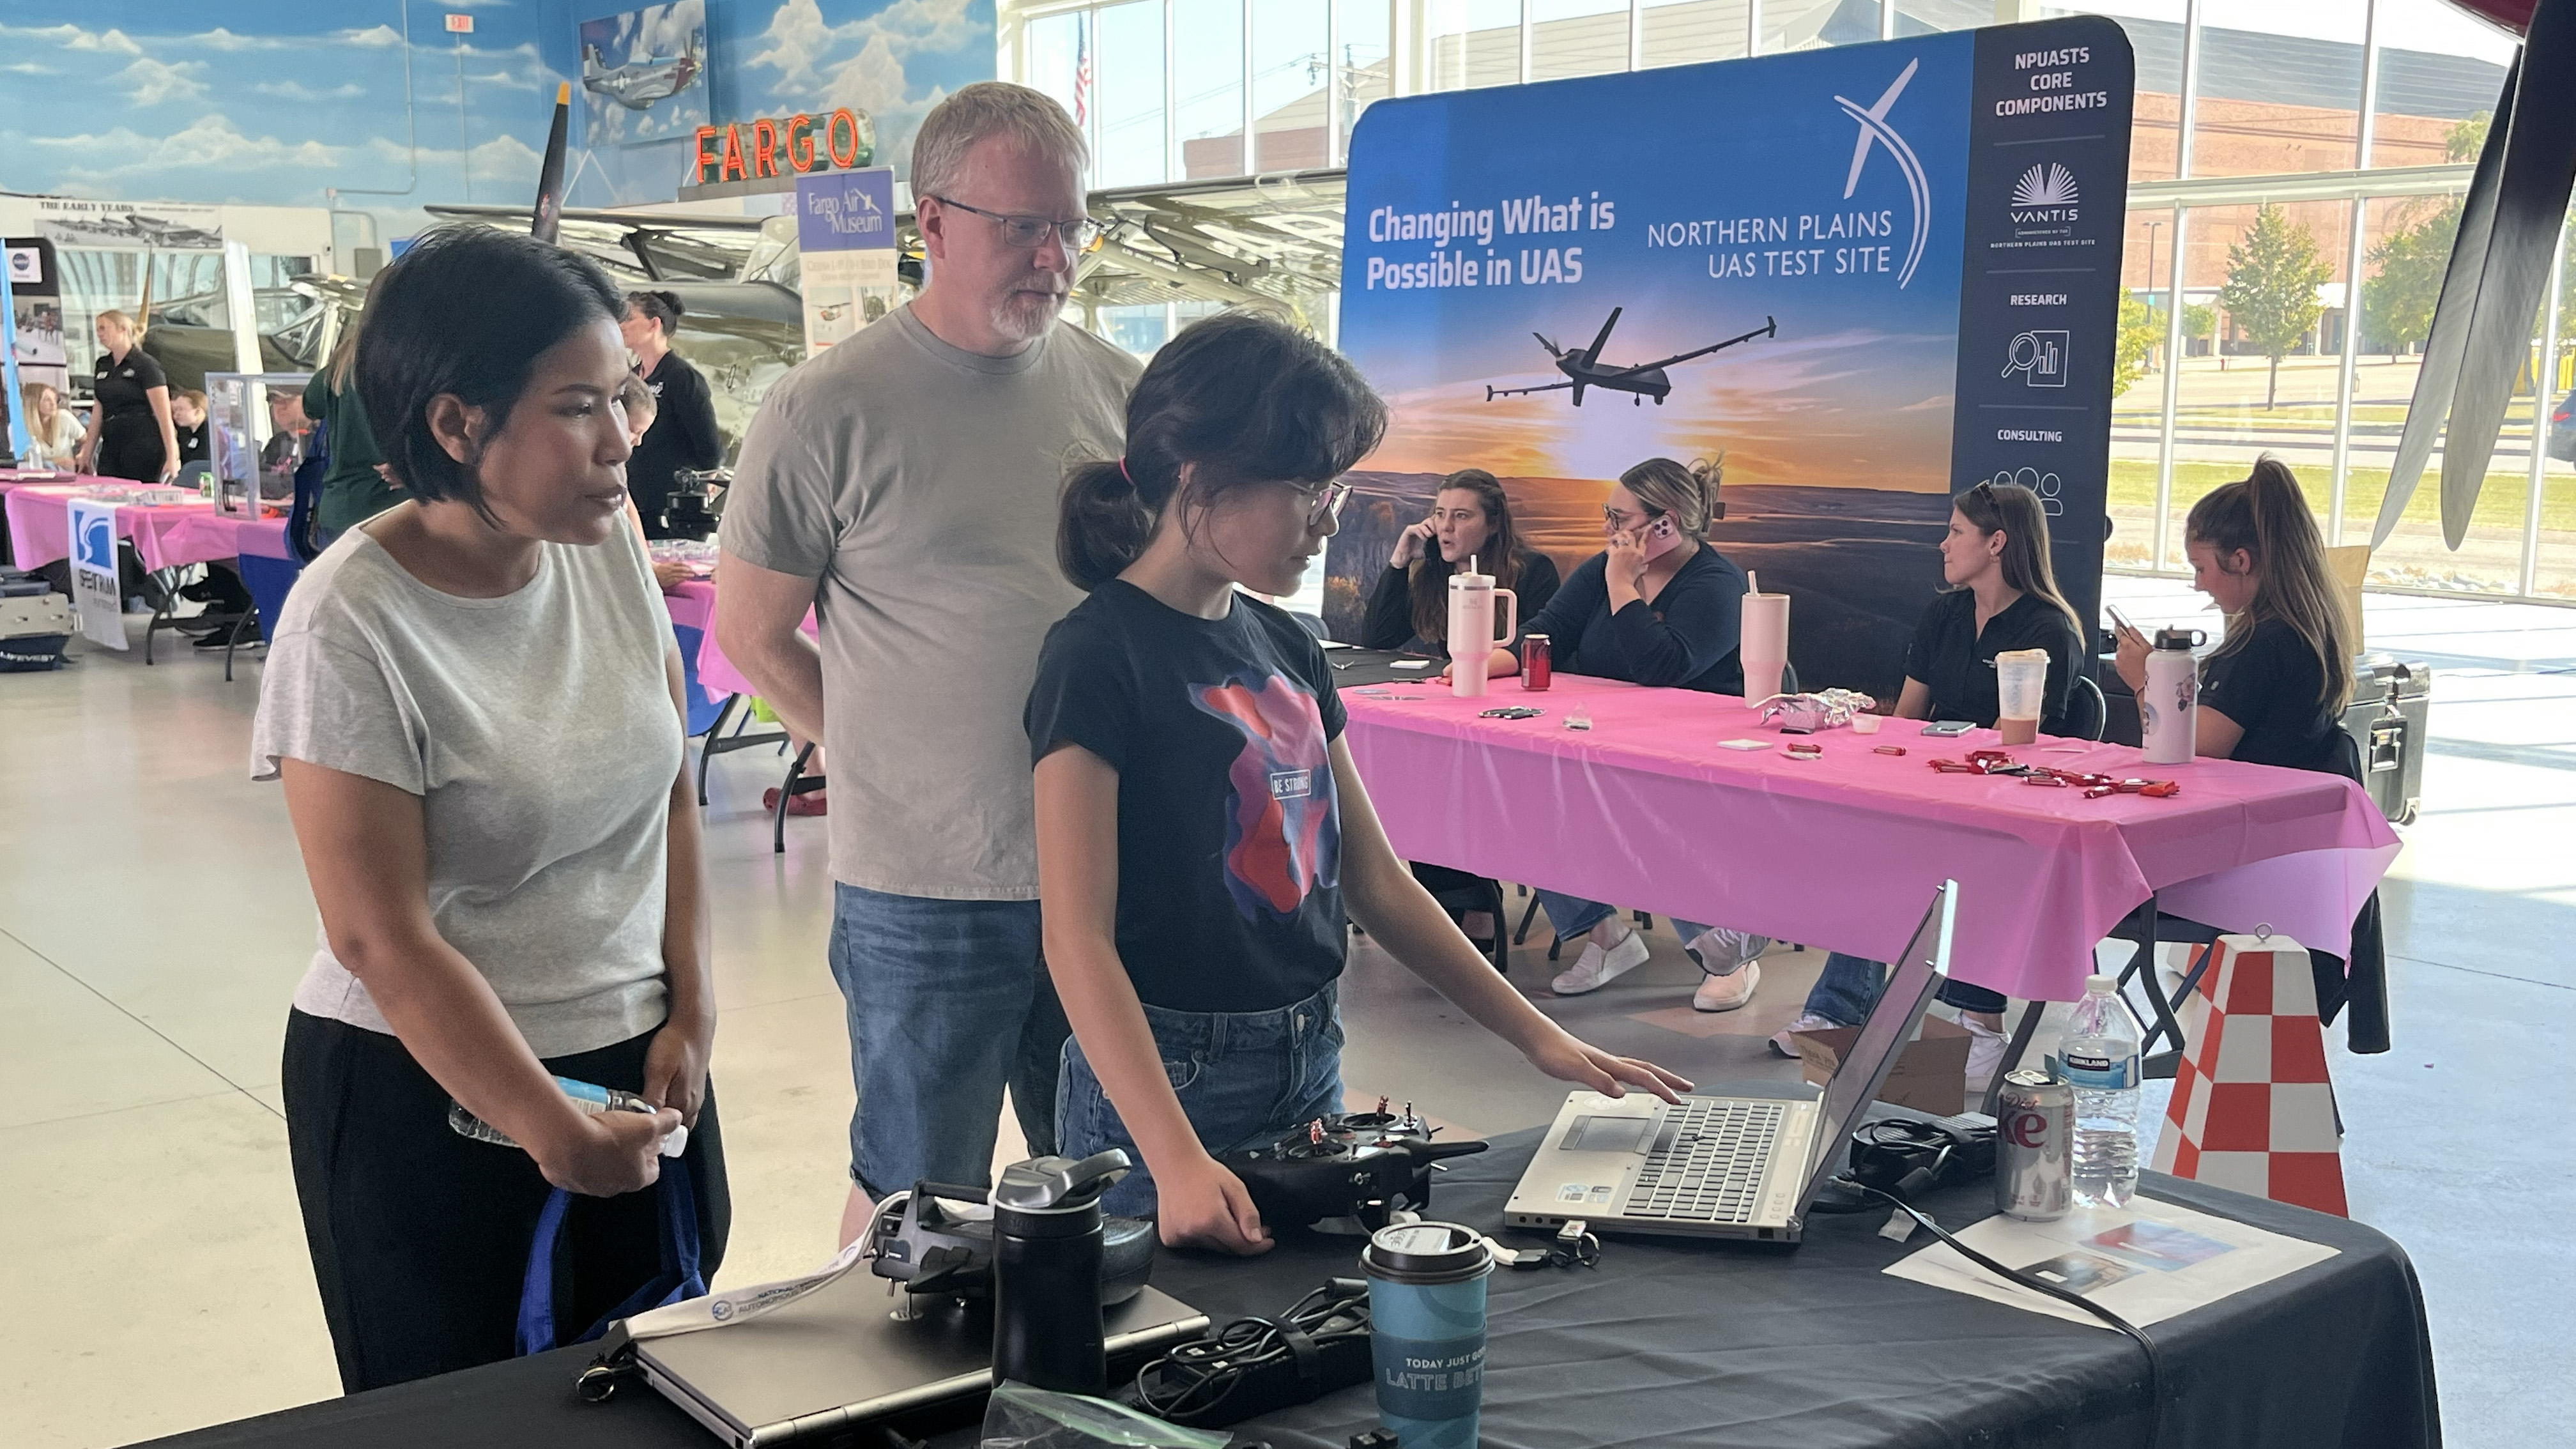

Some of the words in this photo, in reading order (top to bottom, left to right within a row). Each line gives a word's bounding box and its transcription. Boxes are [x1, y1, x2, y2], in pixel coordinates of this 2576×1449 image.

[2015, 47, 2089, 69] NPUASTS
[2030, 72, 2073, 91] CORE
[1996, 91, 2107, 116] COMPONENTS
[695, 107, 857, 183] FARGO
[809, 193, 839, 222] Fargo
[843, 189, 859, 212] Air
[2011, 209, 2078, 223] VANTIS
[832, 213, 882, 234] Museum
[1368, 200, 1494, 248] Changing
[1501, 194, 1583, 234] What
[1590, 191, 1615, 231] is
[1648, 217, 1787, 248] NORTHERN
[1798, 210, 1892, 241] PLAINS
[1367, 247, 1478, 290] Possible
[1485, 248, 1512, 286] in
[1520, 247, 1583, 284] UAS
[1708, 252, 1756, 279] UAS
[1764, 249, 1823, 277] TEST
[1835, 246, 1890, 274] SITE
[2011, 294, 2067, 305] RESEARCH
[1997, 429, 2062, 442] CONSULTING
[2004, 1092, 2039, 1110] Diet
[1406, 1358, 1444, 1368] TODAY
[1446, 1354, 1470, 1368] JUST
[1386, 1368, 1448, 1391] LATTE
